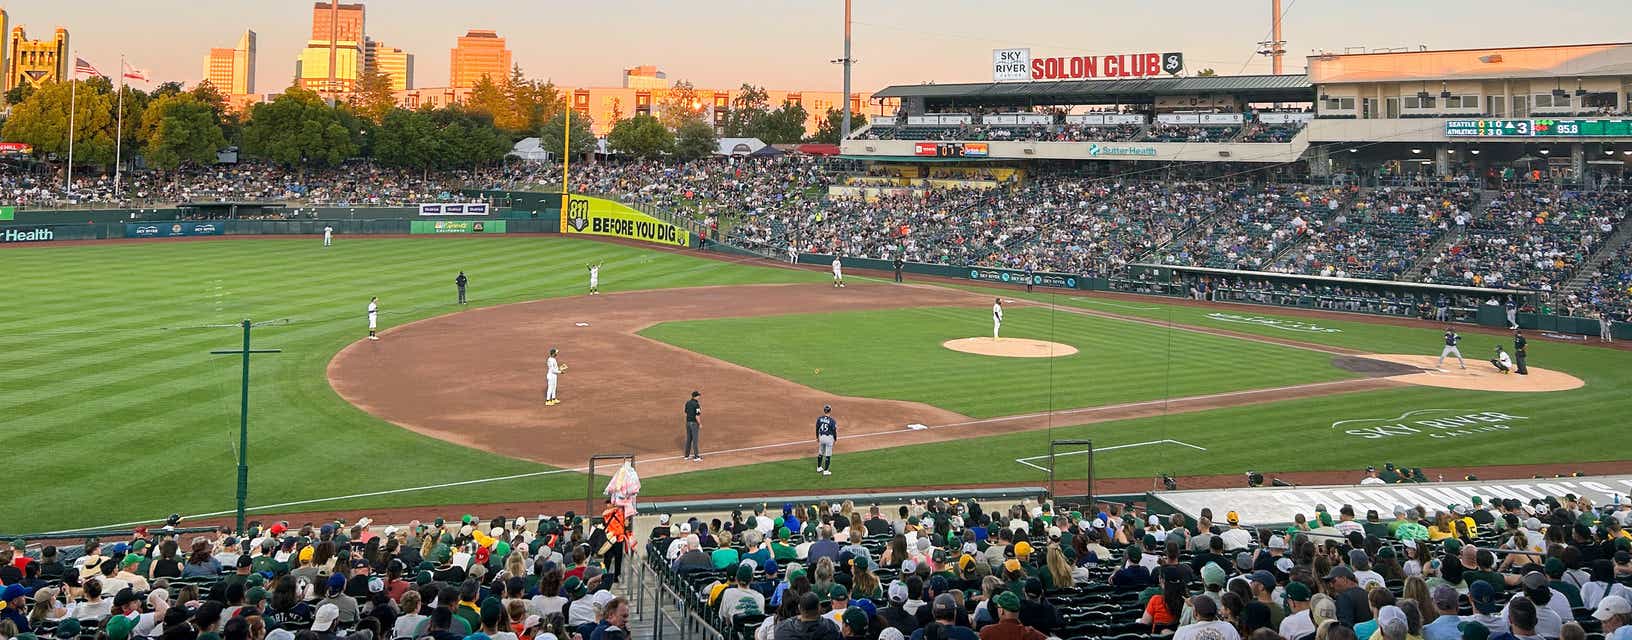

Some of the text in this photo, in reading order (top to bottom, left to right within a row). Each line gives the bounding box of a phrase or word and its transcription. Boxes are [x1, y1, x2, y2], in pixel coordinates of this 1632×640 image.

[1000, 51, 1021, 61] SKY
[995, 64, 1026, 73] RIVER
[1031, 53, 1161, 80] SOLON CLUB
[1517, 122, 1528, 134] 3
[1557, 124, 1578, 133] 95.8
[569, 199, 589, 220] 811
[5, 228, 54, 241] Health
[592, 217, 676, 242] BEFORE YOU DIG
[819, 423, 829, 432] 45
[1345, 411, 1513, 439] SKY RIVER
